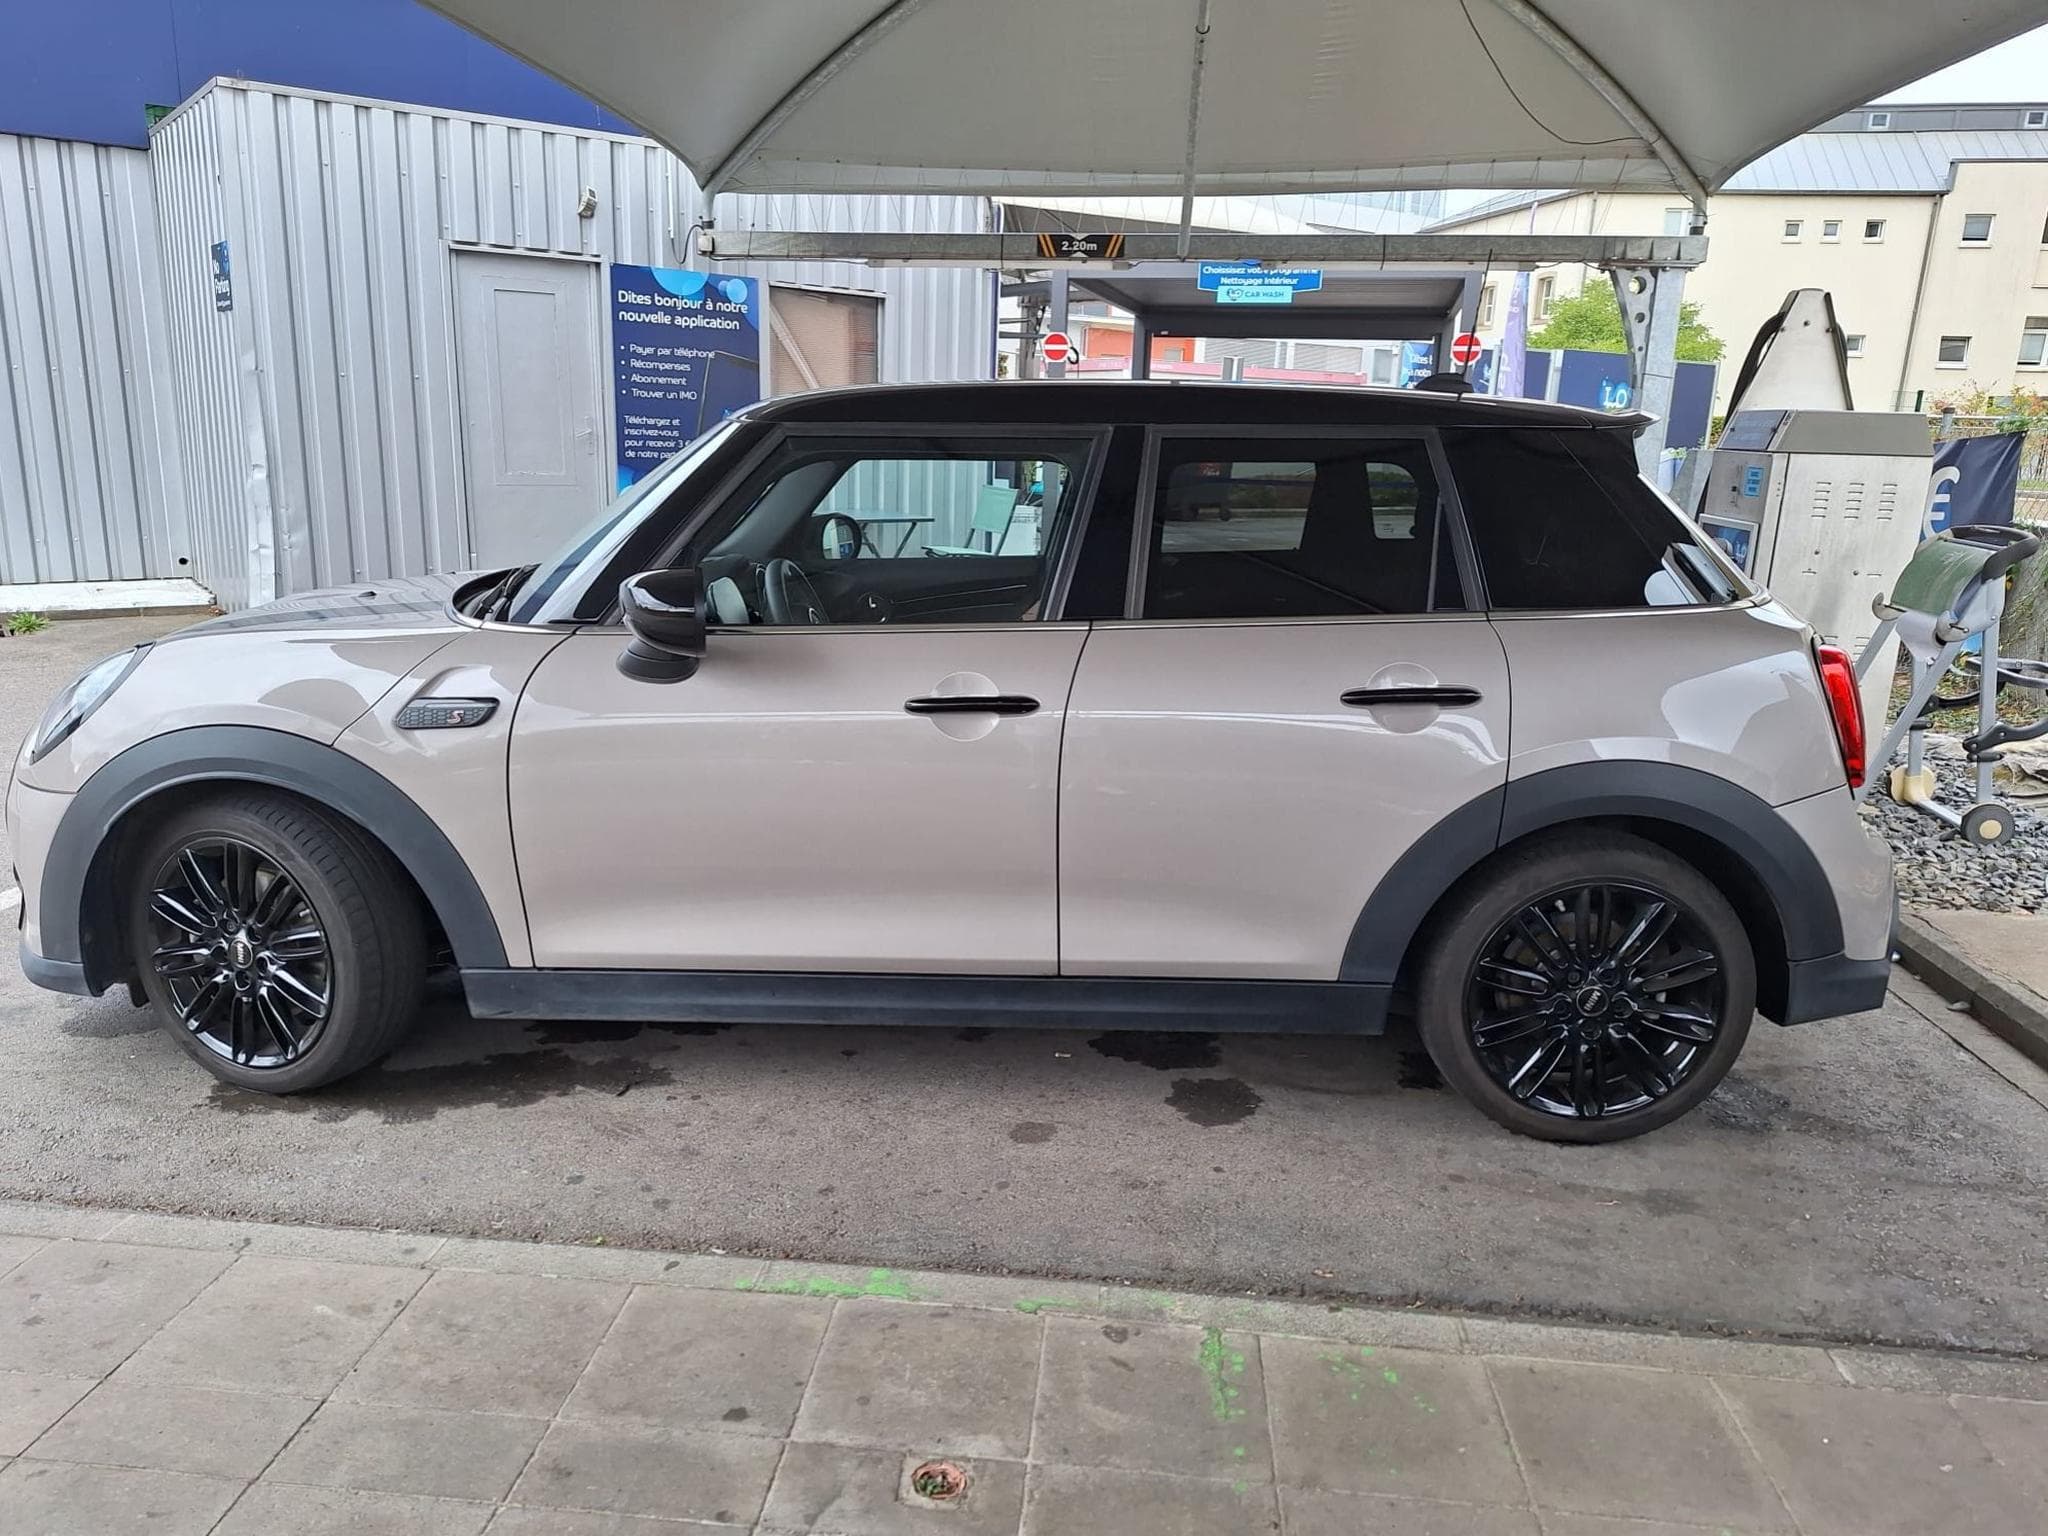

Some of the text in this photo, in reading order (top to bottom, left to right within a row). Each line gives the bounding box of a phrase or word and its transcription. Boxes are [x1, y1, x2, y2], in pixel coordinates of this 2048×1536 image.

[1061, 241, 1097, 251] 2.20m
[1220, 276, 1299, 285] Nettoyage Intérieur
[618, 290, 748, 313] Dites bonjour à notre
[619, 311, 740, 330] nouvelle application
[629, 344, 715, 358] Payer par téléphone
[630, 358, 691, 371] Récompenses
[630, 373, 687, 386] Abonnement
[631, 387, 697, 400] Trouver un IMO
[624, 415, 681, 426] Téléchargez et
[624, 427, 680, 437] inscrivez-vous
[624, 440, 644, 448] pour
[645, 439, 676, 448] recevoir
[677, 440, 684, 448] 3
[625, 449, 636, 458] de
[637, 450, 659, 458] notre
[446, 709, 464, 724] S
